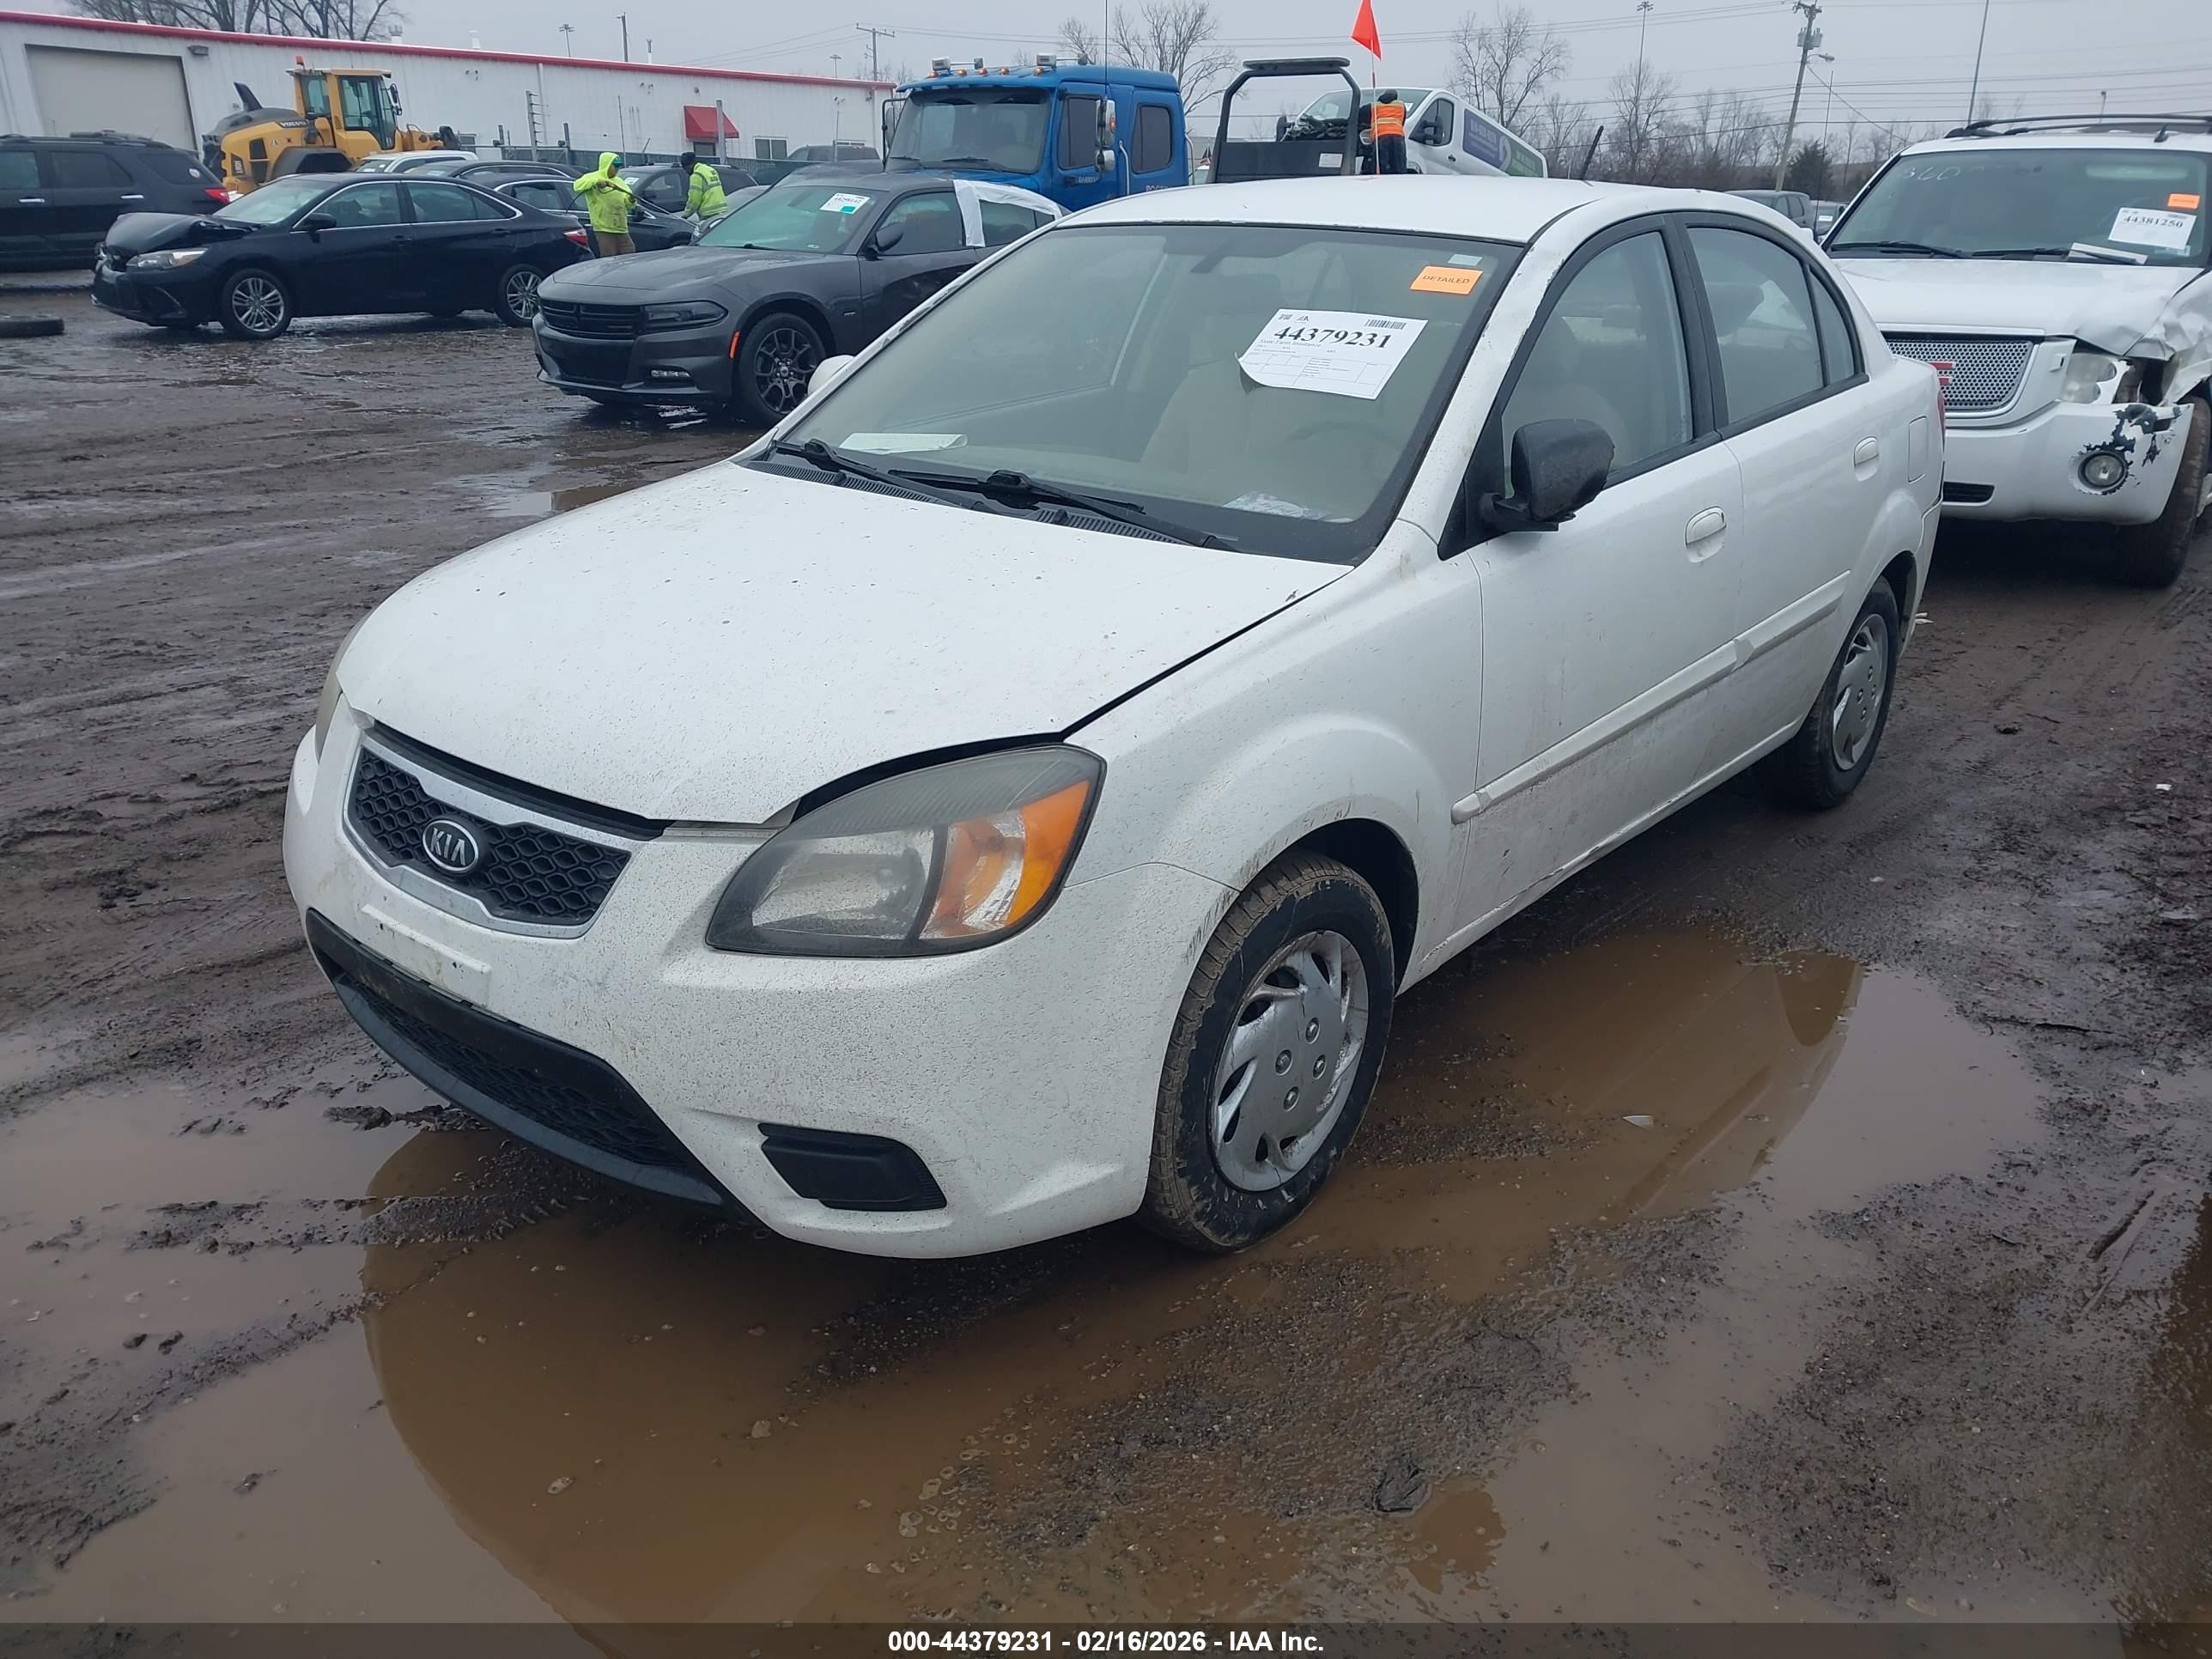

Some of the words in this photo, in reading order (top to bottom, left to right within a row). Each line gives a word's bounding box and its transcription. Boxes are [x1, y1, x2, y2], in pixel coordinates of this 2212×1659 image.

[1422, 275, 1470, 283] DETAILED
[1273, 326, 1392, 349] 44379231
[430, 827, 466, 866] KIA
